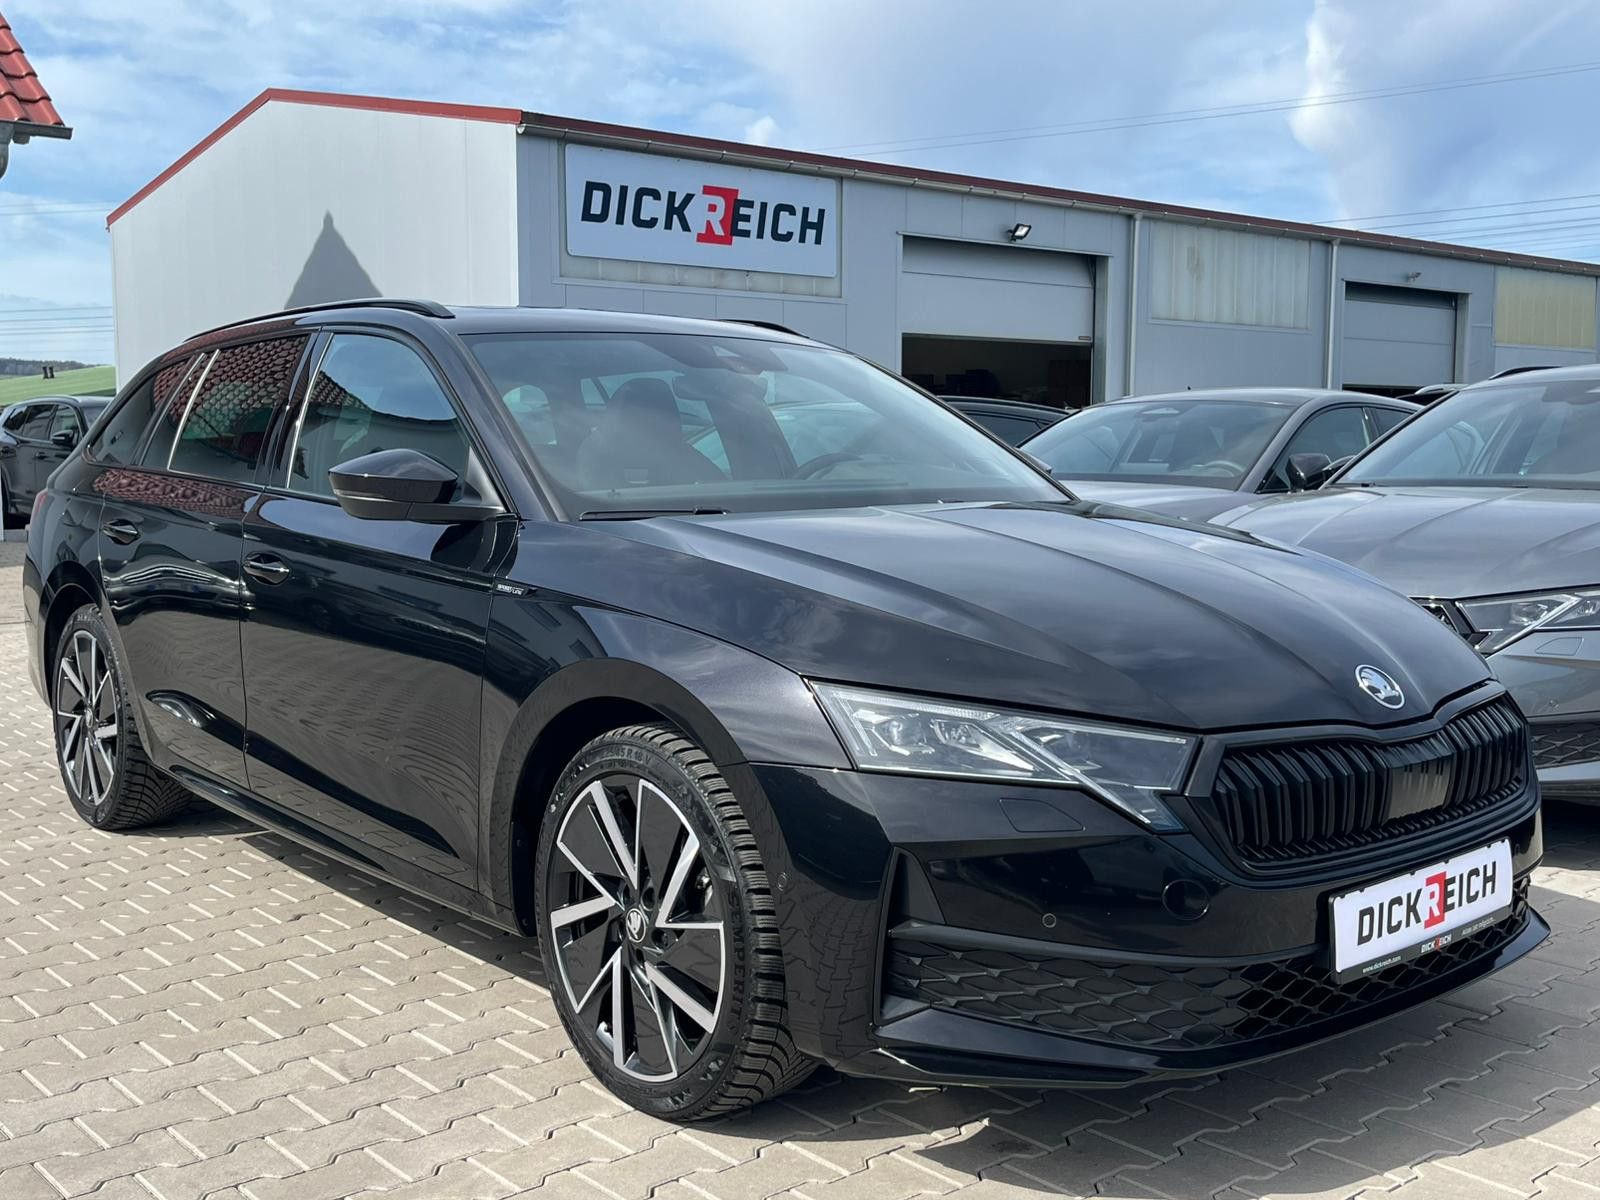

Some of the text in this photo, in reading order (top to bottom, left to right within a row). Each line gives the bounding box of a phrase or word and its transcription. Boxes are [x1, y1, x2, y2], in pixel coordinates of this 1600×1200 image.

[581, 181, 826, 246] DICKREICH
[1357, 861, 1497, 946] DICKREICH
[1421, 934, 1452, 953] DICKREICH
